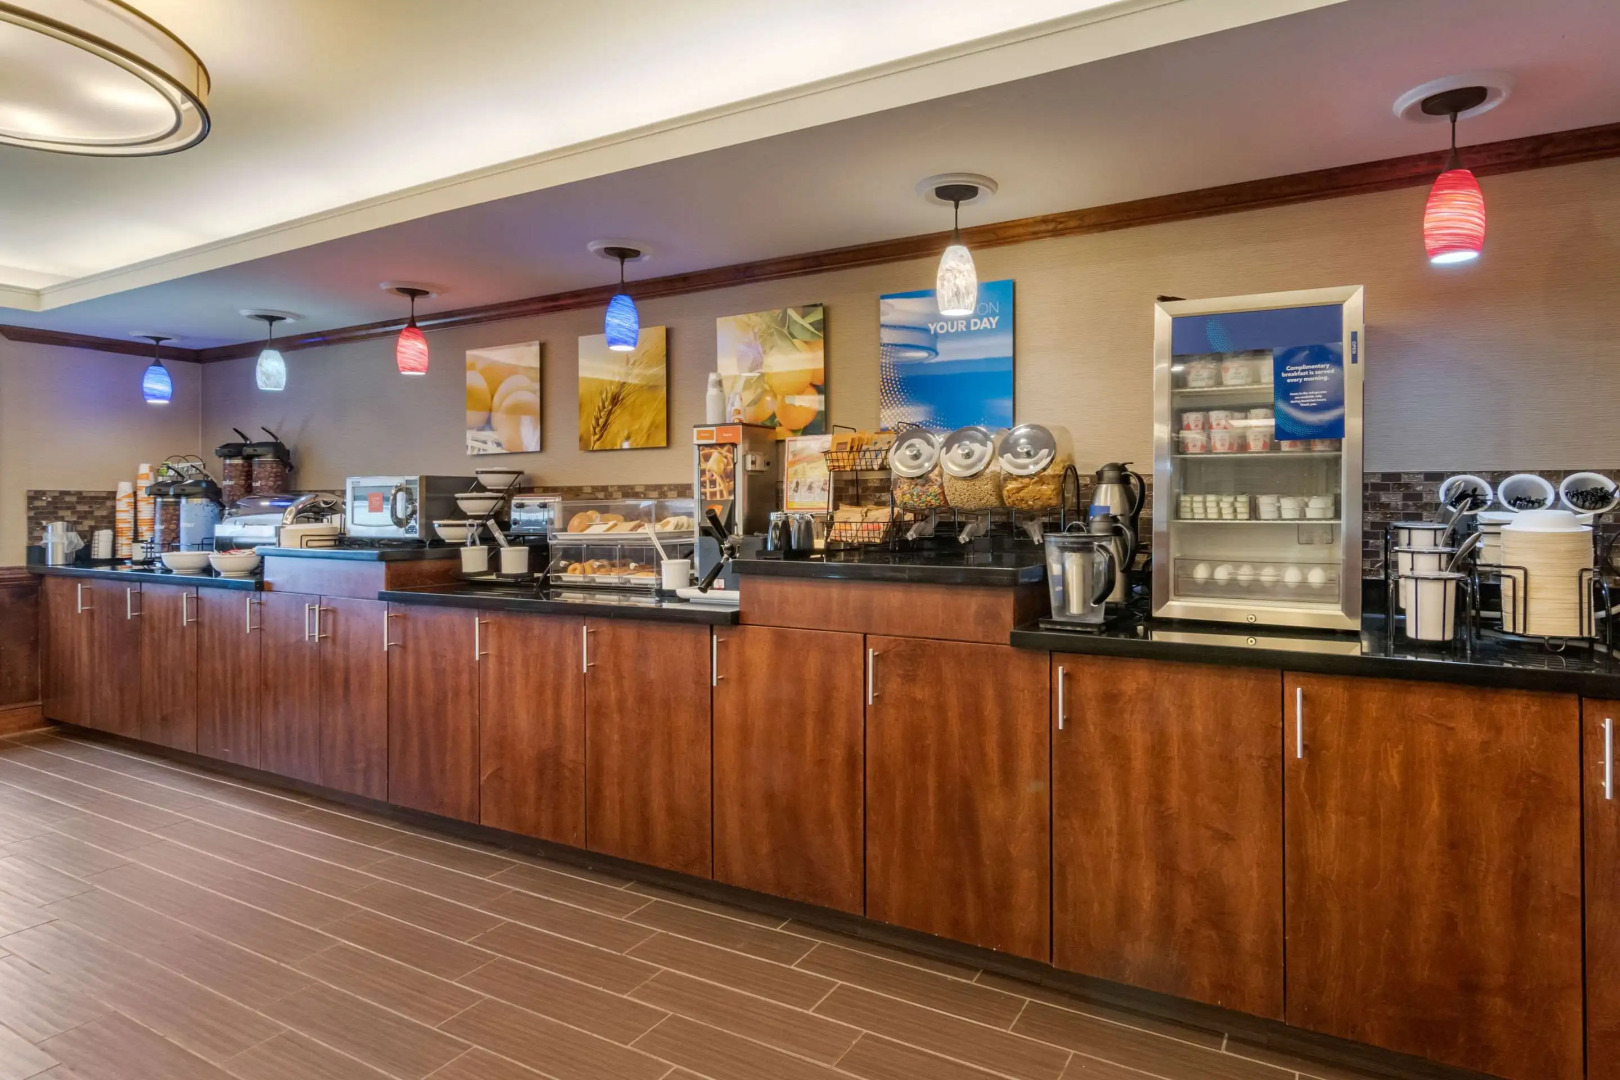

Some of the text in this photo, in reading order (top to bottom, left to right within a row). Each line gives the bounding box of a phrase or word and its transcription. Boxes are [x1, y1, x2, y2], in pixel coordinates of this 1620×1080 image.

[977, 301, 1000, 316] ON
[928, 316, 1000, 335] YOUR DAY
